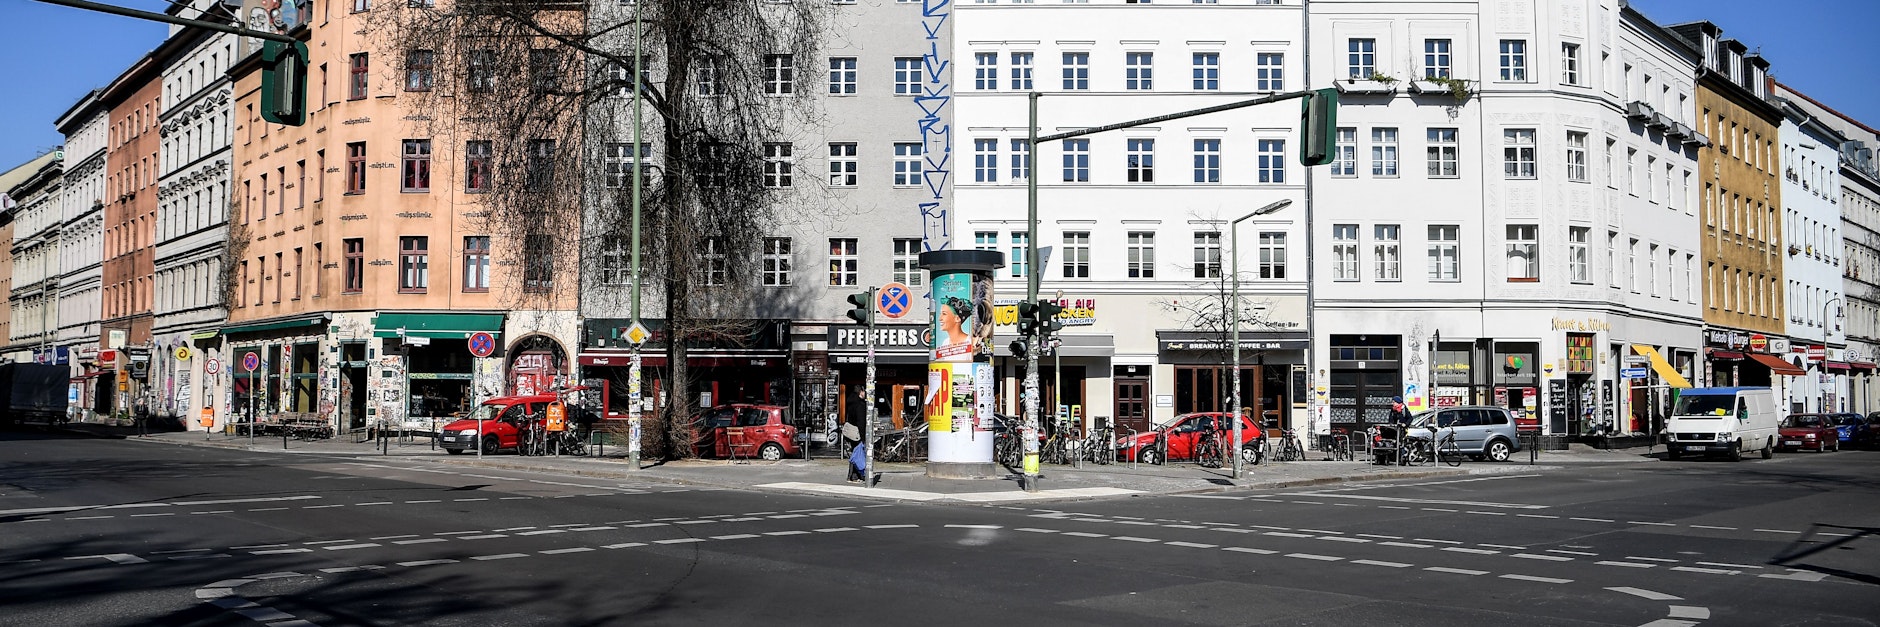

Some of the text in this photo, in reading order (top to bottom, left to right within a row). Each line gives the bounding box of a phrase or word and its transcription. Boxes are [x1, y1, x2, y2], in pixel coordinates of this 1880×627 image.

[1056, 308, 1094, 319] CKEN
[837, 328, 918, 346] PFEIFFERS
[1733, 333, 1749, 348] Burger
[208, 362, 217, 371] 30
